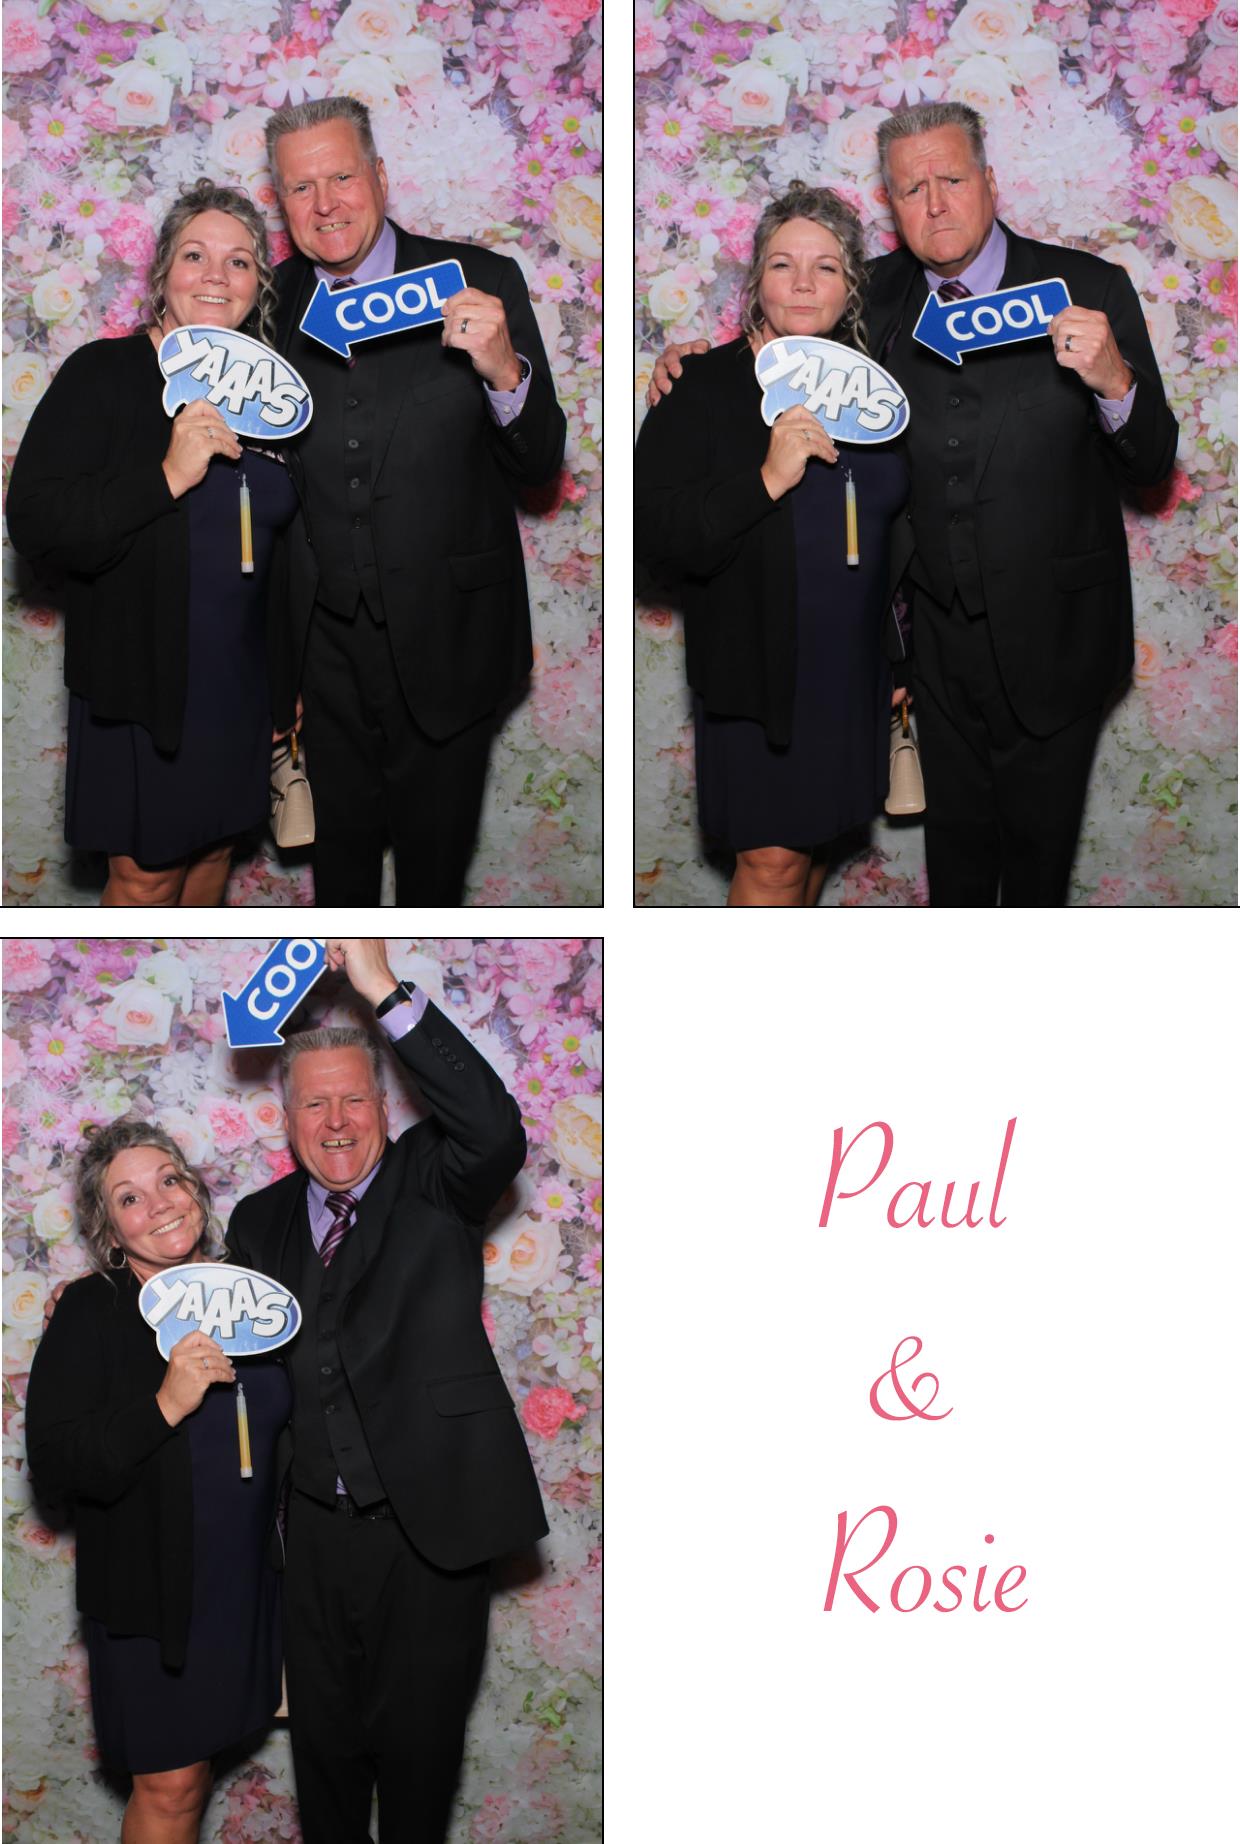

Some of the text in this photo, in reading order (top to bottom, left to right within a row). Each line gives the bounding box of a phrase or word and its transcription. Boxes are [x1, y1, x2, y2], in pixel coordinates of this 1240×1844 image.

[335, 277, 449, 330] COOL
[945, 294, 1054, 340] COOL
[160, 329, 309, 428] YAAAS
[759, 341, 906, 432] YAAAS
[146, 1277, 294, 1340] YAAAS
